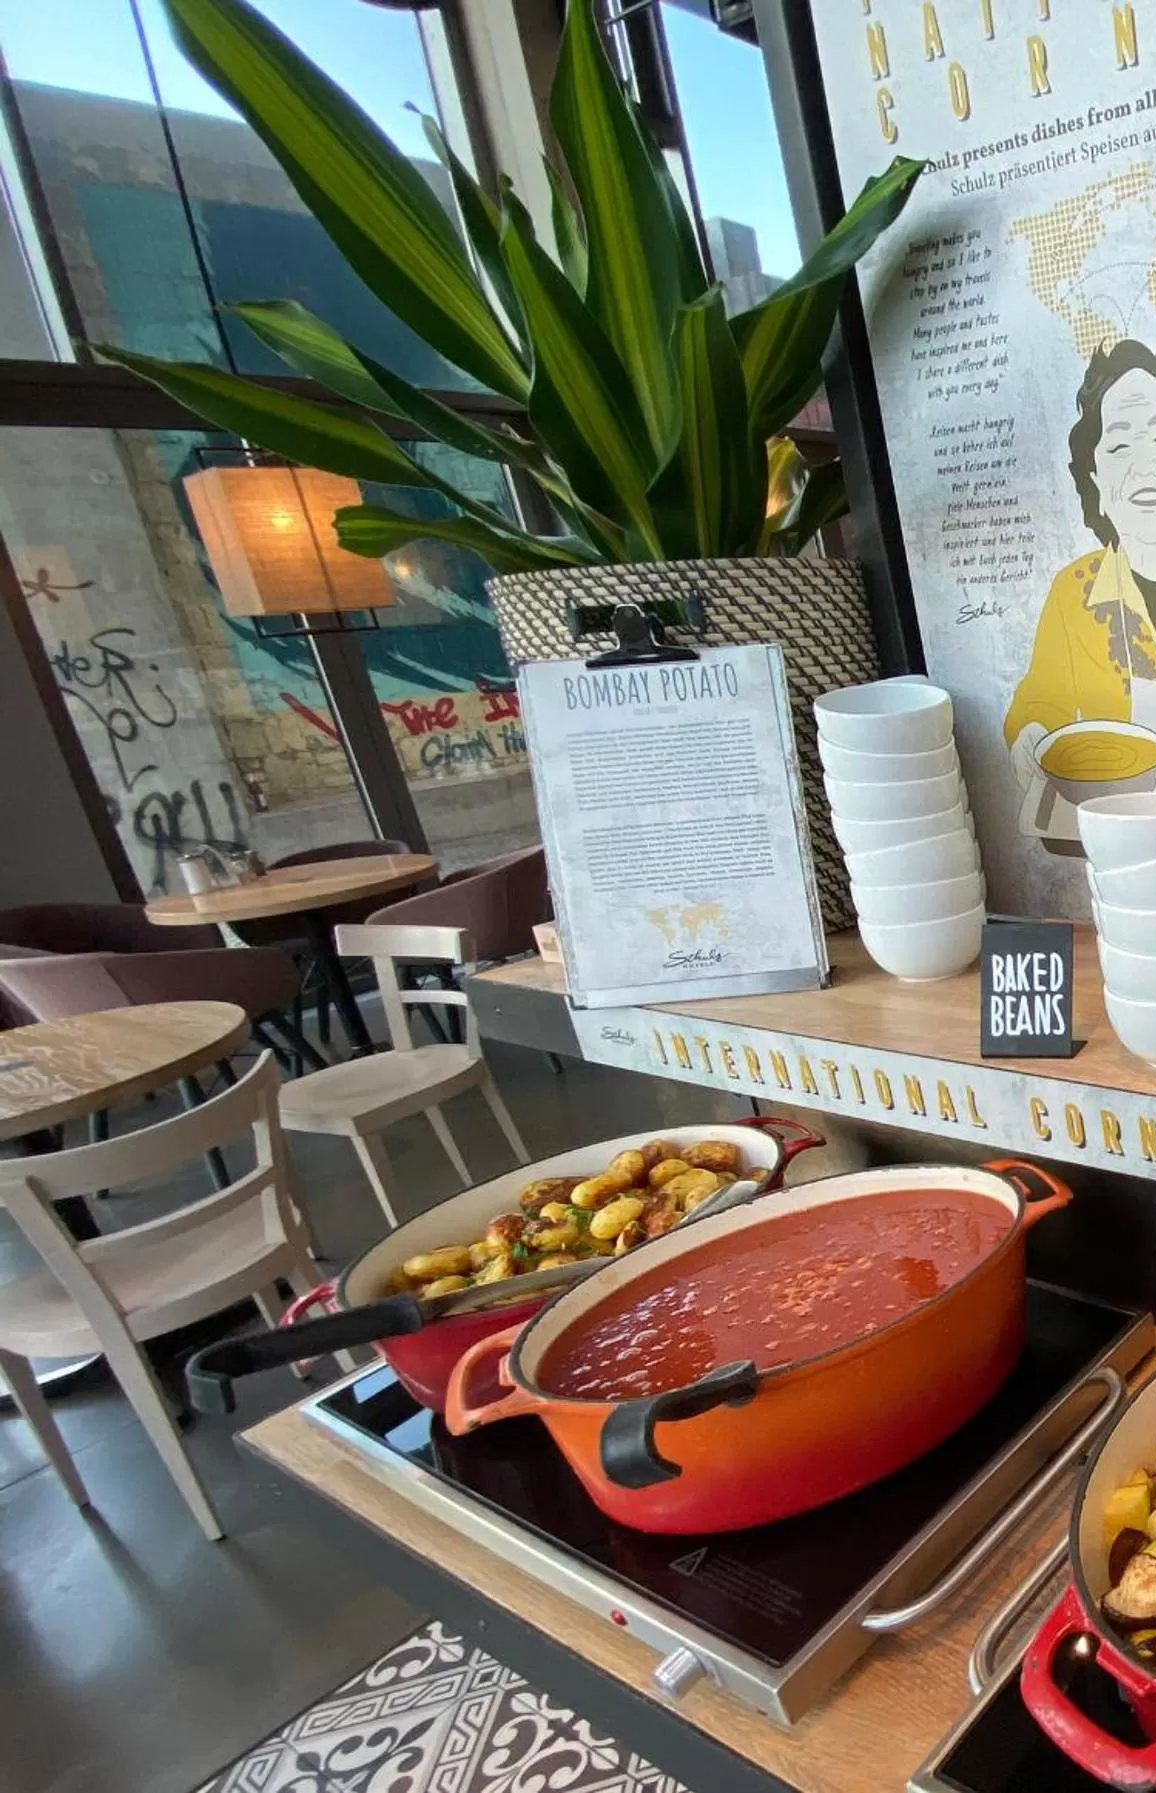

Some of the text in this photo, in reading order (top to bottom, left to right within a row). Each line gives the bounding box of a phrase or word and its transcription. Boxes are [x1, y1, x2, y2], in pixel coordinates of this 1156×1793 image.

[921, 152, 960, 176] hulz
[962, 133, 1029, 169] presents
[1031, 116, 1085, 144] dishes
[1087, 102, 1132, 127] from
[951, 170, 996, 197] Schulz
[999, 147, 1078, 189] präsentiert
[1080, 131, 1139, 164] Speisen
[960, 317, 973, 331] and
[975, 337, 988, 349] and
[954, 357, 989, 375] different
[944, 384, 959, 402] you
[563, 662, 738, 711] BOMBAY POTATO
[991, 952, 1064, 993] BAKED
[990, 993, 1066, 1037] BEANS
[652, 1028, 988, 1129] INTERNATIONAL
